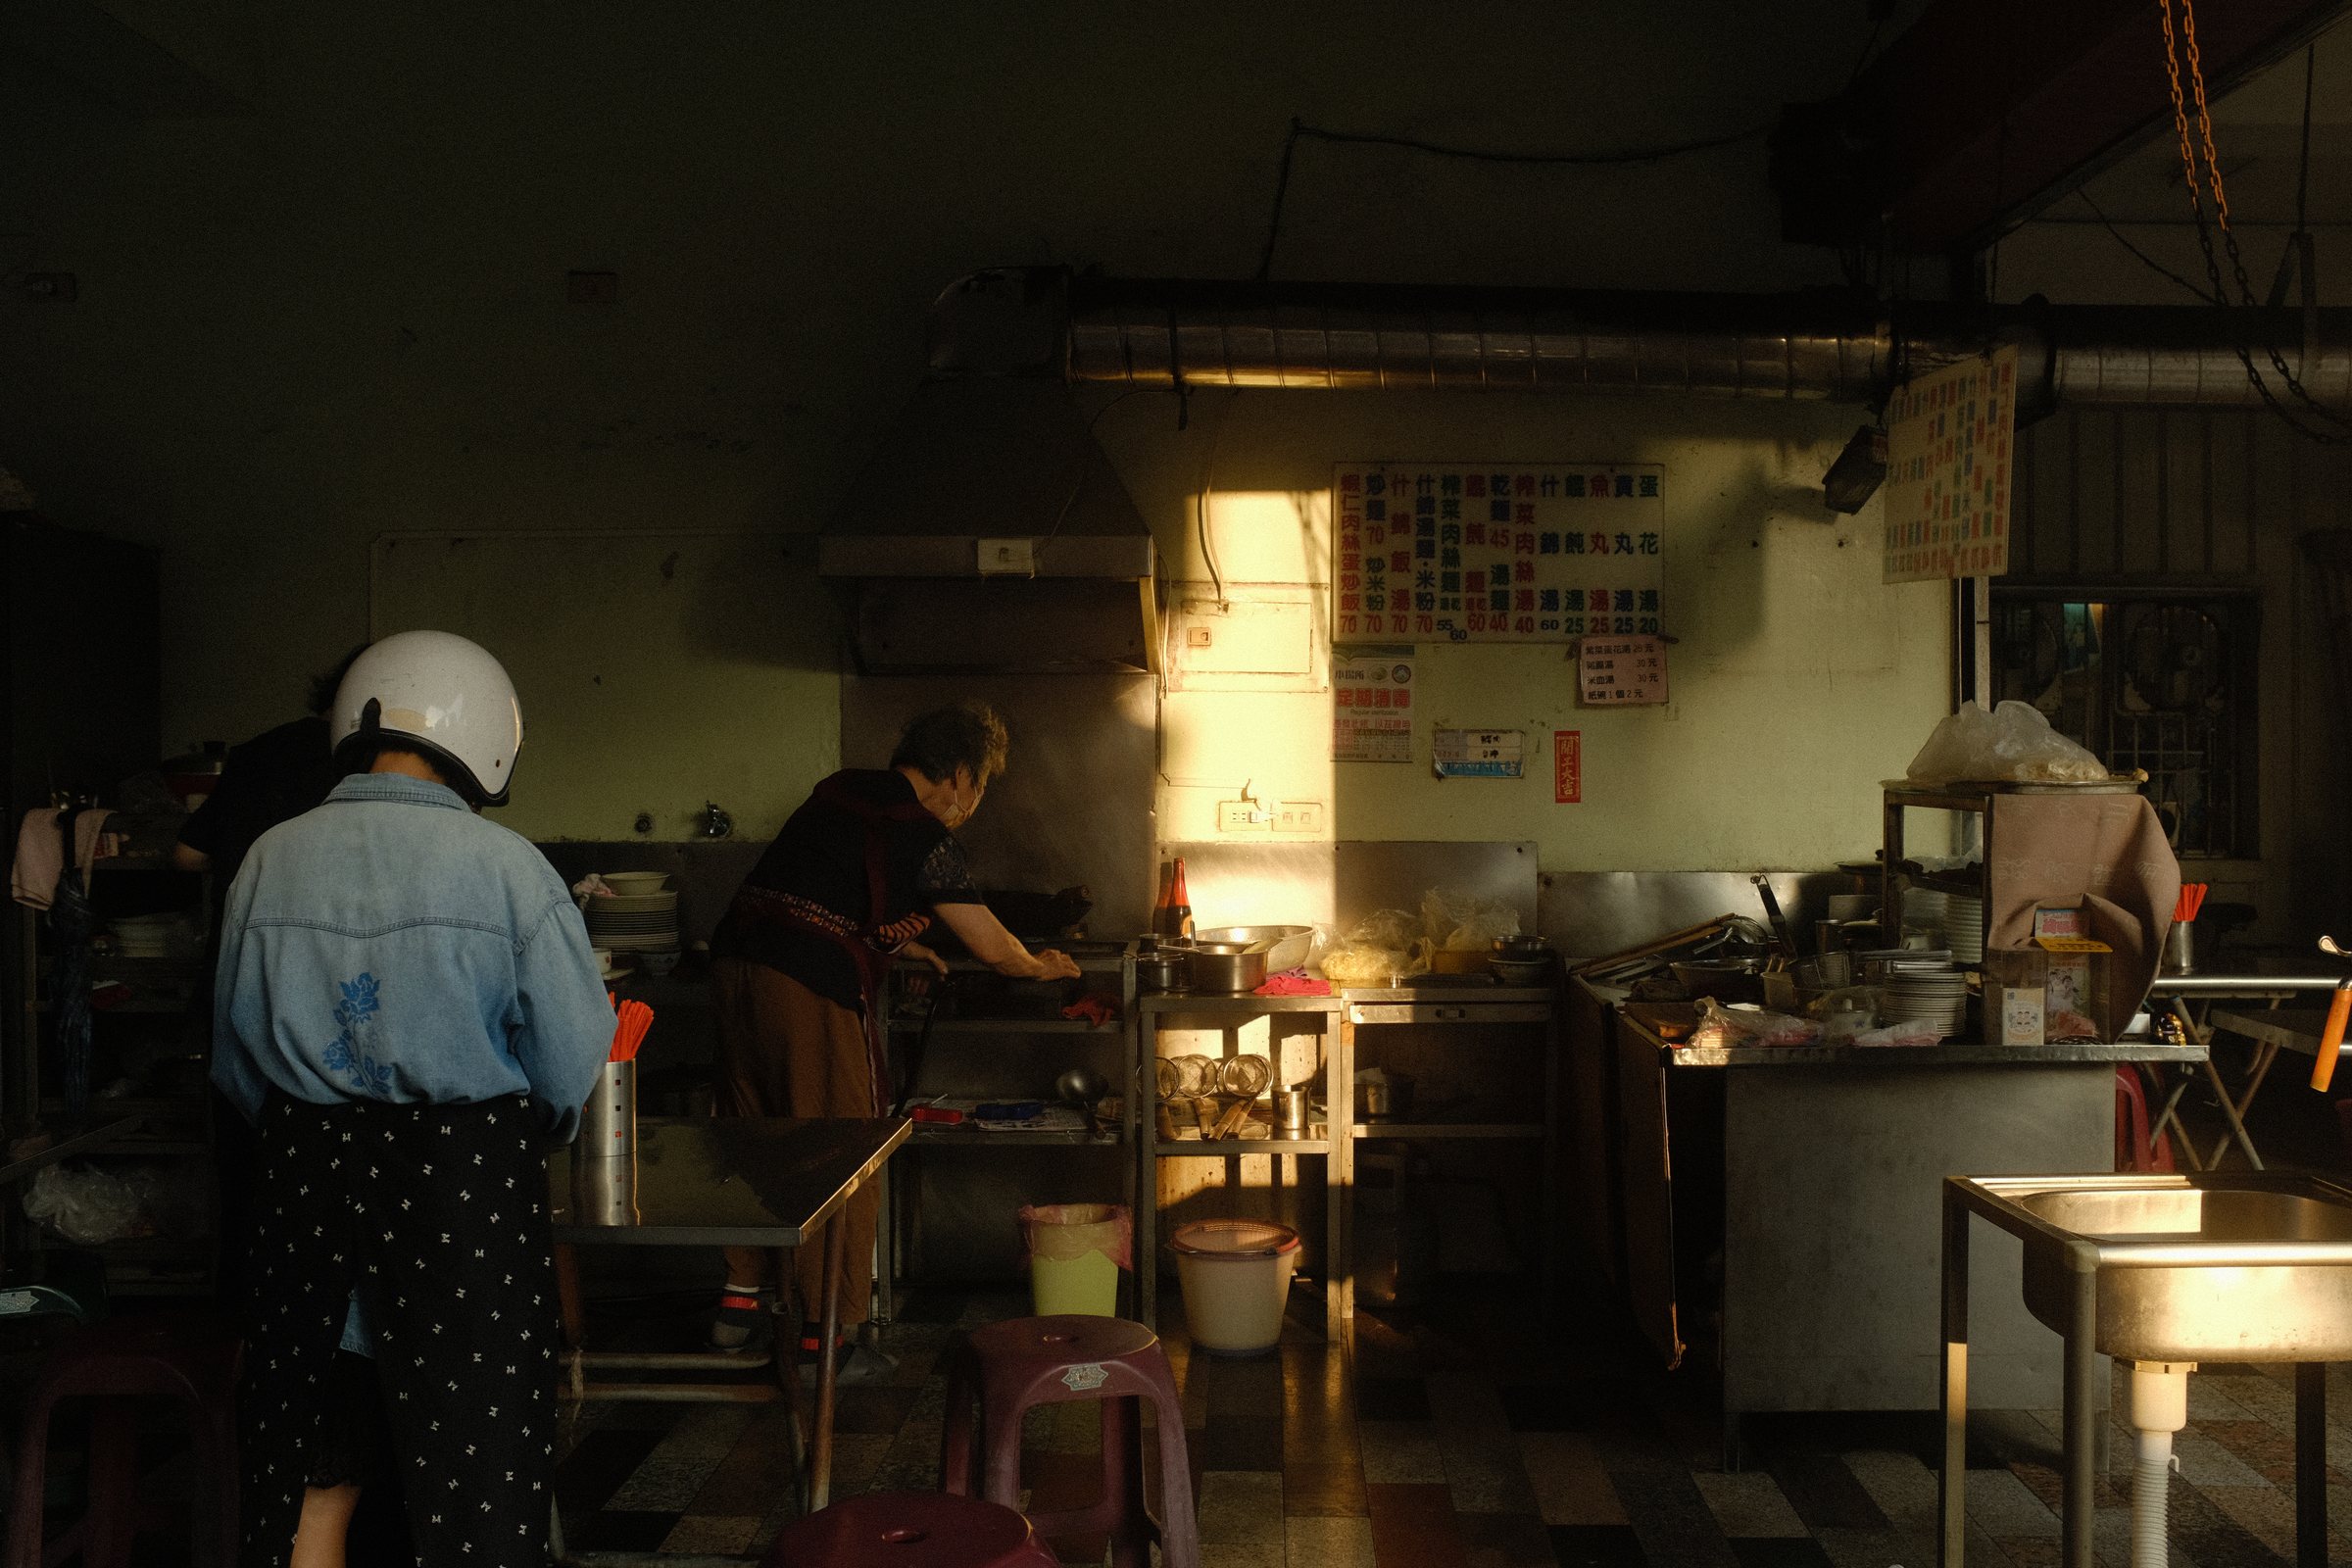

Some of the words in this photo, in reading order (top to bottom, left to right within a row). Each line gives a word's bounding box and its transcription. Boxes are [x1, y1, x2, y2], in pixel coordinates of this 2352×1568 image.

[1366, 526, 1384, 545] 70
[1490, 529, 1509, 548] 45
[1590, 474, 1609, 612] 魚丸湯
[1640, 475, 1658, 612] 蛋花湯
[1366, 557, 1386, 611] 炒米粉
[1340, 614, 1356, 633] 70
[1365, 614, 1382, 633] 70
[1392, 614, 1407, 633] 70
[1416, 614, 1433, 633] 70
[1437, 619, 1453, 631] 55
[1449, 629, 1467, 641] 60
[1468, 613, 1486, 631] 60
[1490, 612, 1507, 632] 40
[1515, 616, 1534, 633] 40
[1541, 619, 1558, 630] 60
[1565, 617, 1584, 634] 25
[1590, 617, 1609, 633] 25
[1615, 617, 1634, 634] 25
[1640, 617, 1658, 634] 20
[1645, 643, 1654, 653] 元
[1637, 659, 1645, 667] 30
[1647, 658, 1657, 667] 元
[1638, 673, 1646, 682] 30
[1648, 672, 1659, 682] 元
[1634, 688, 1643, 698] 元
[1561, 739, 1574, 796] 開工大吉
